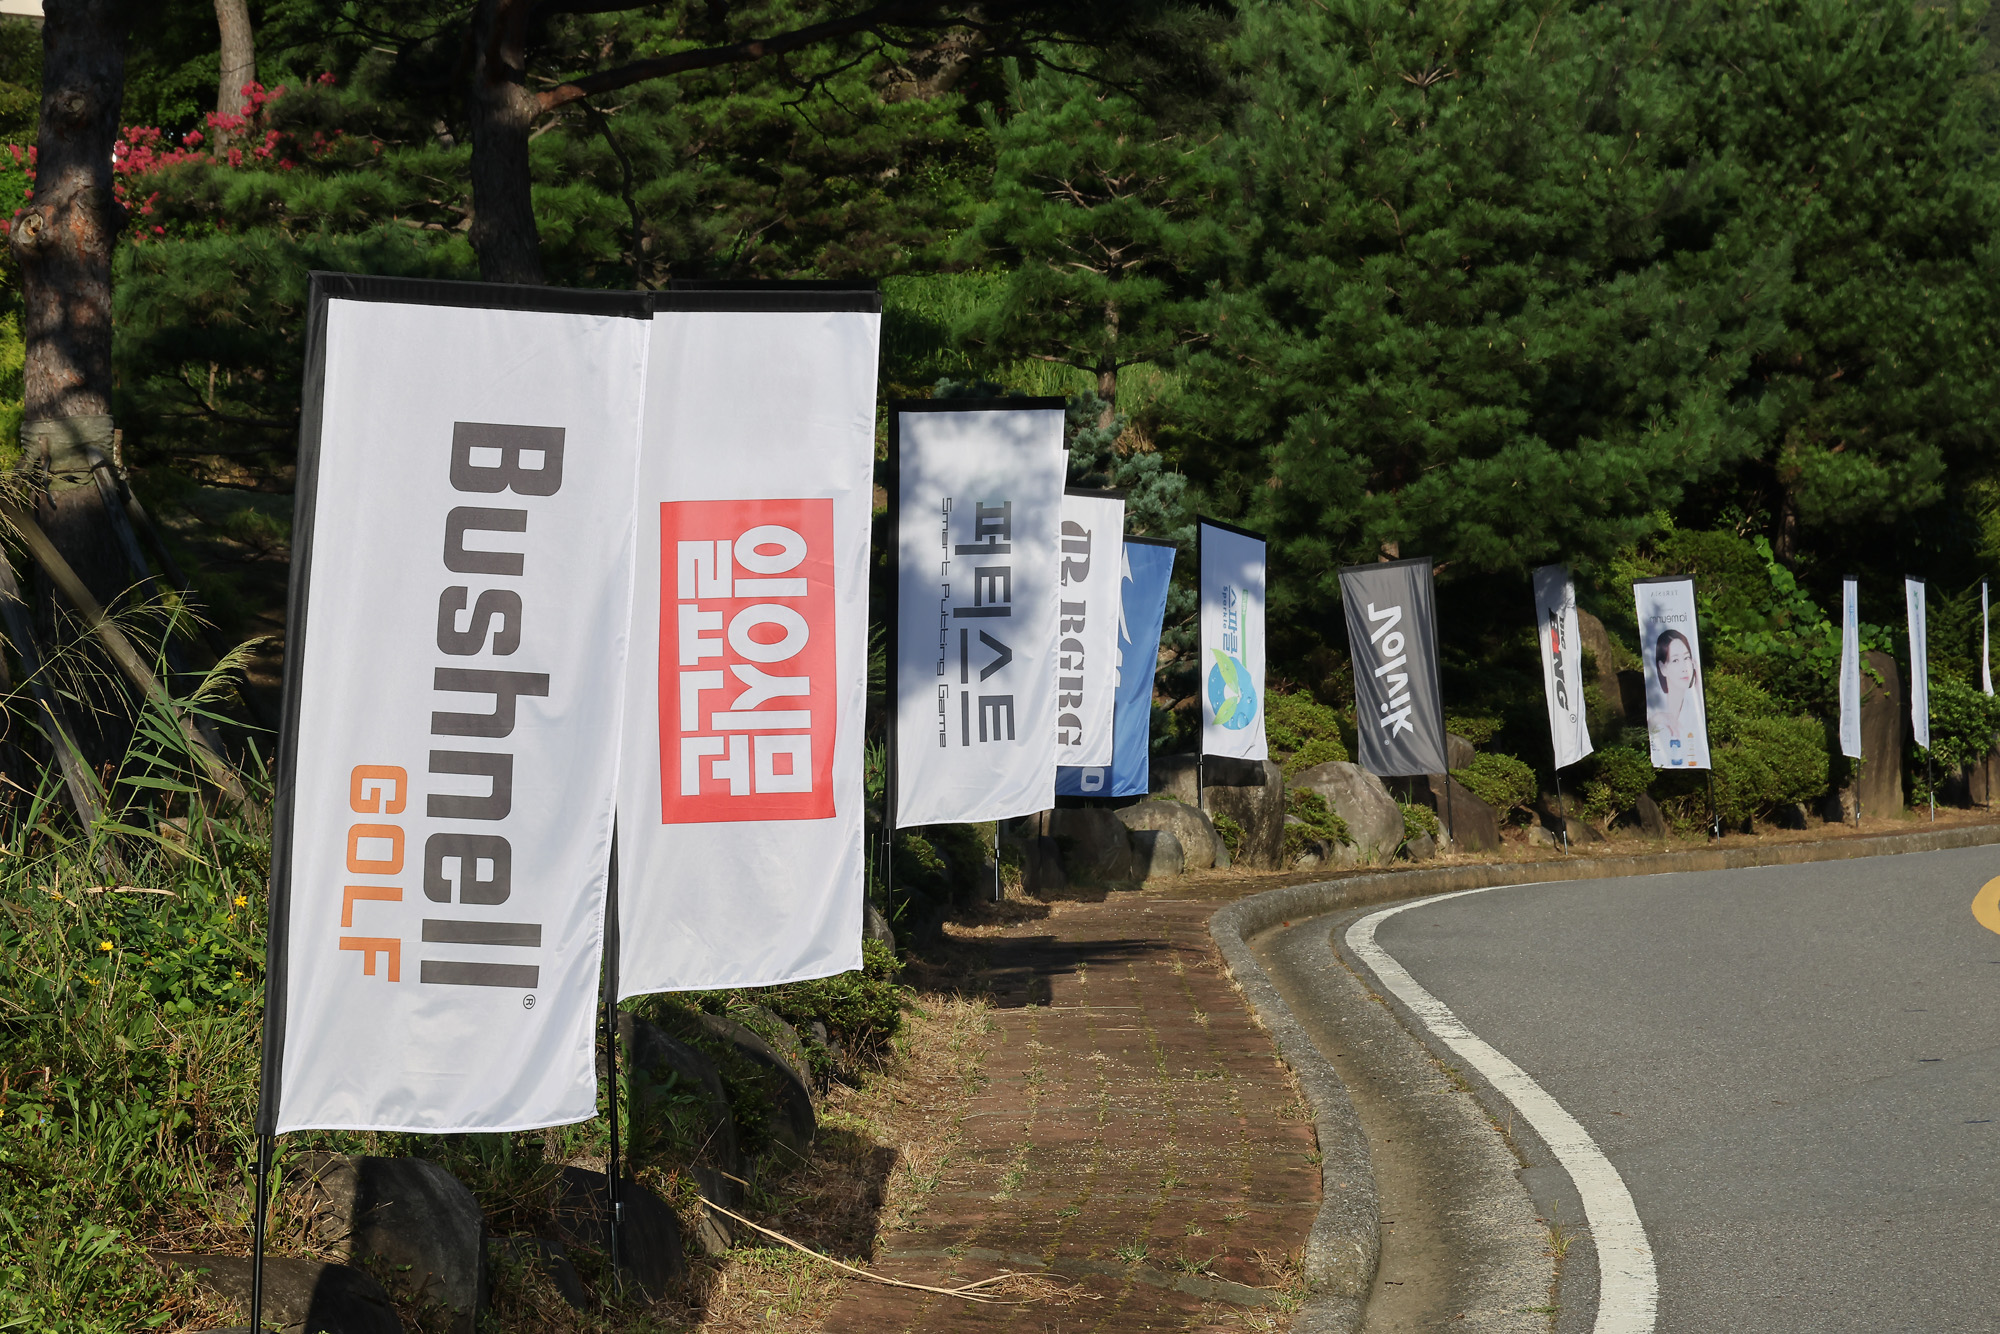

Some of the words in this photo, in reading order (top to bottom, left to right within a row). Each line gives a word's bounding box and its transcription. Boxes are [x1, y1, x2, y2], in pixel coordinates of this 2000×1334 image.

[942, 498, 952, 576] Smart
[676, 524, 812, 797] 일요신문
[936, 583, 951, 676] Putting
[953, 501, 1016, 747] 퍼티스트
[1222, 585, 1238, 654] 스파클
[420, 421, 566, 989] Bushnell
[938, 684, 949, 748] Game
[338, 765, 408, 983] GOLF
